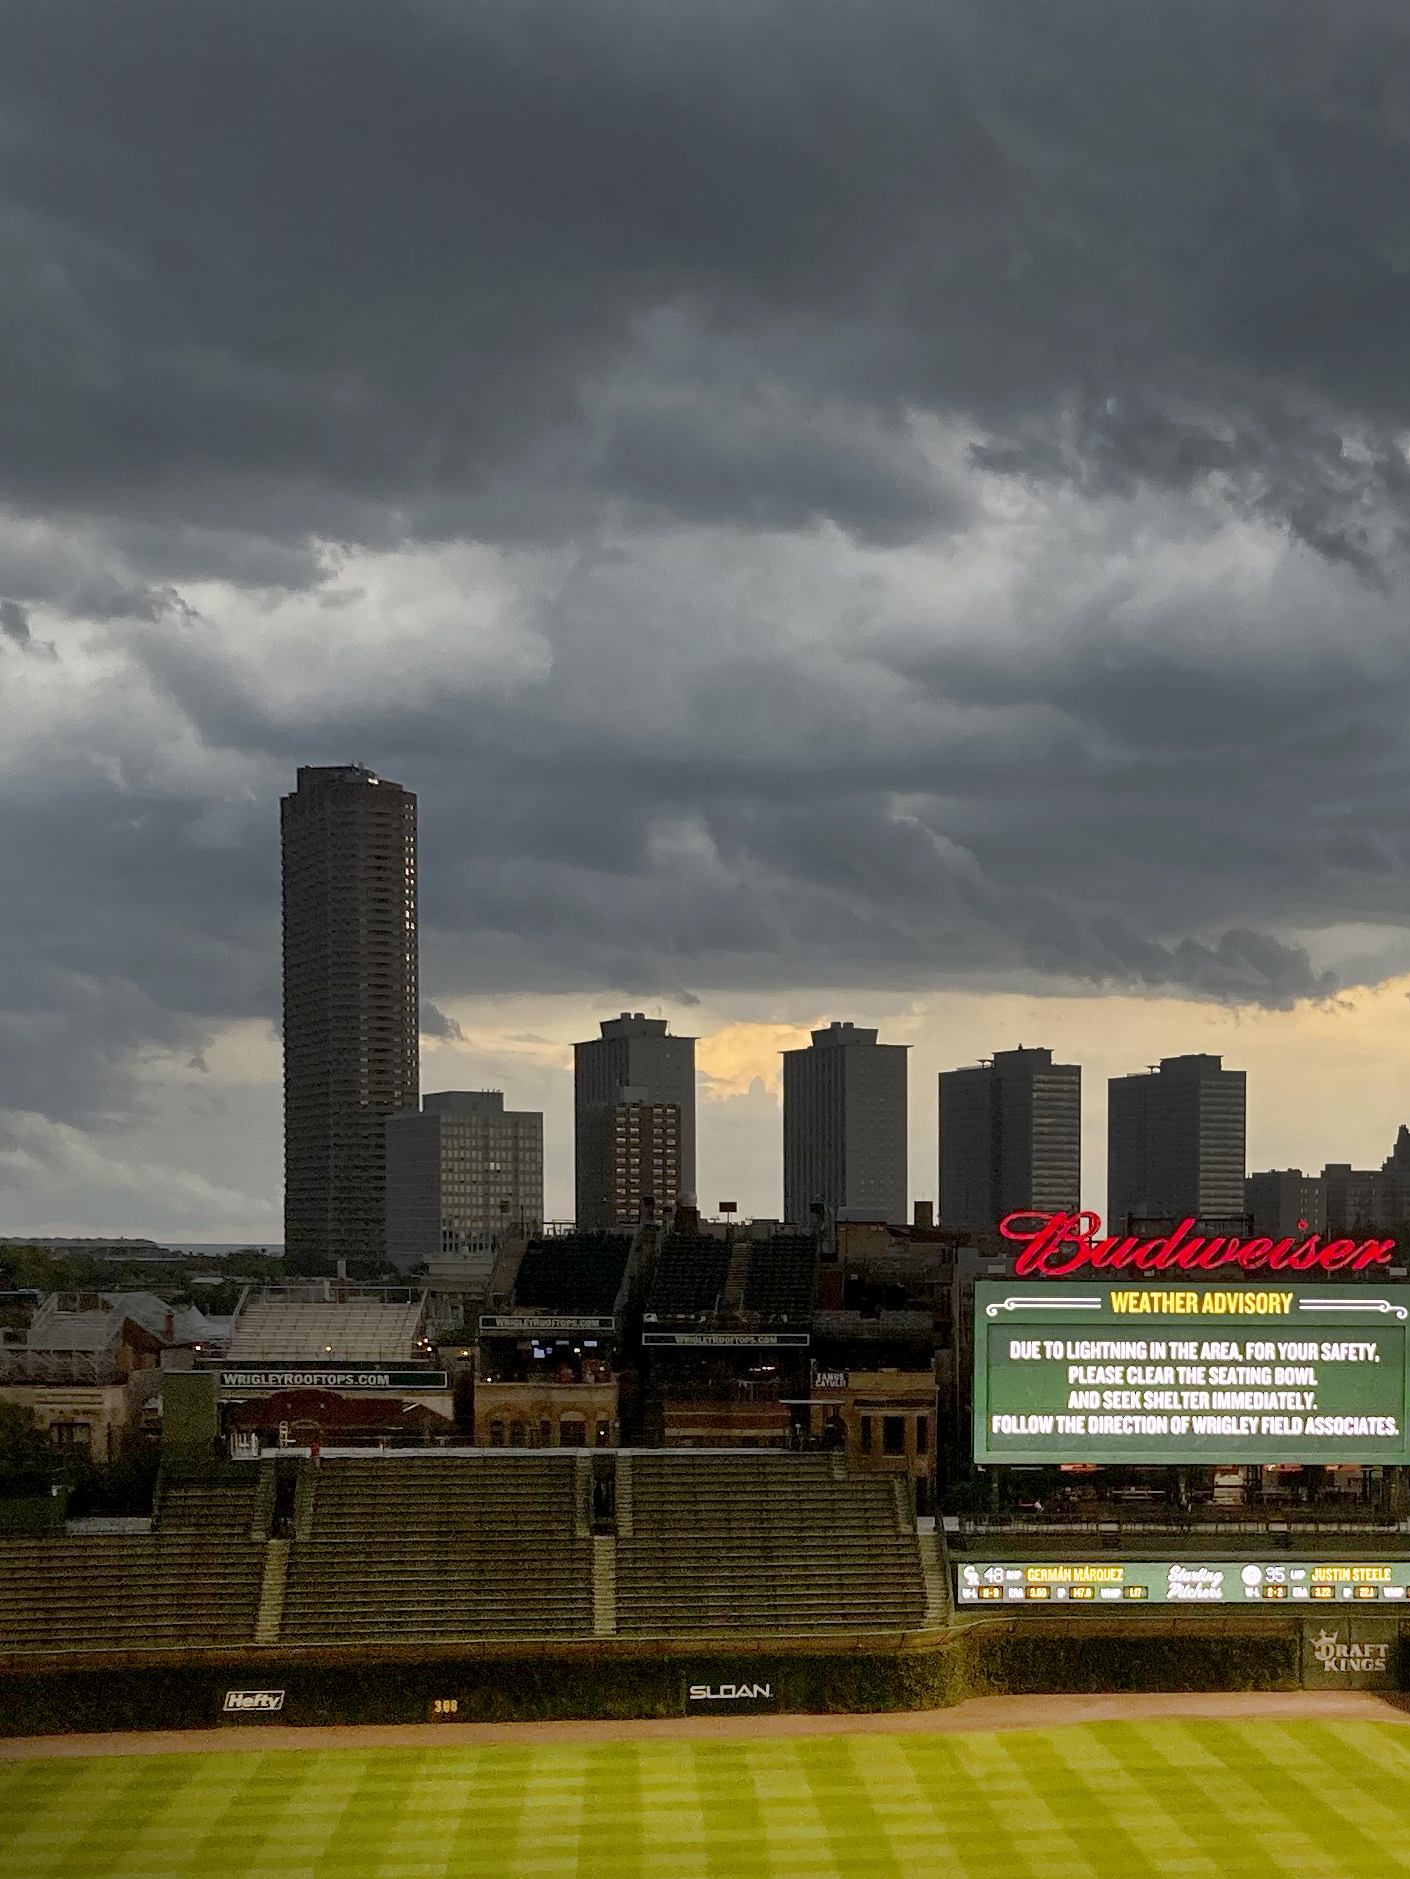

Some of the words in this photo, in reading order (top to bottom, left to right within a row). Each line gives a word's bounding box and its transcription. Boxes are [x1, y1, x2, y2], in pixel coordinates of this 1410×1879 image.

[1000, 1211, 1397, 1276] Budweiser
[1111, 1292, 1198, 1314] WEATHER
[1202, 1292, 1293, 1314] ADVISORY
[1010, 1340, 1041, 1360] DUE
[1043, 1340, 1063, 1360] TO
[1066, 1340, 1147, 1360] LIGHTNING
[1150, 1341, 1166, 1360] IN
[1169, 1341, 1198, 1360] THE
[1200, 1341, 1243, 1362] AREA,
[1246, 1342, 1275, 1361] FOR
[1277, 1342, 1318, 1361] YOUR
[1320, 1342, 1380, 1363] SAFETY,
[223, 1373, 390, 1386] WRIGLEYROOFTOPS.COM
[1068, 1365, 1124, 1385] PLEASE
[1126, 1365, 1174, 1385] CLEAR
[1176, 1366, 1206, 1385] THE
[1208, 1366, 1271, 1385] SEATING
[1274, 1366, 1318, 1386] BOWL
[1068, 1391, 1100, 1410] AND
[1102, 1391, 1142, 1410] SEEK
[1143, 1391, 1209, 1410] SHELTER
[1212, 1391, 1318, 1410] IMMEDIATELY.
[991, 1415, 1054, 1434] FOLLOW
[1056, 1415, 1085, 1434] THE
[1088, 1415, 1168, 1434] DIRECTION
[1170, 1415, 1190, 1434] OF
[1192, 1416, 1259, 1435] WRIGLEY
[1261, 1416, 1303, 1435] FIELD
[1304, 1416, 1400, 1436] ASSOCIATES.
[984, 1566, 1005, 1583] 48
[1027, 1566, 1071, 1582] GERMÁN
[1073, 1566, 1124, 1582] MÁRQUEZ
[1167, 1564, 1224, 1586] Starting
[1265, 1566, 1286, 1583] 35
[1311, 1567, 1350, 1582] JUSTIN
[1352, 1567, 1392, 1582] STEELE
[1166, 1581, 1224, 1600] Pitchers
[1314, 1643, 1389, 1661] DRAFT
[1323, 1658, 1387, 1671] KINGS
[228, 1693, 281, 1709] Hefty
[690, 1683, 770, 1700] SLOAN
